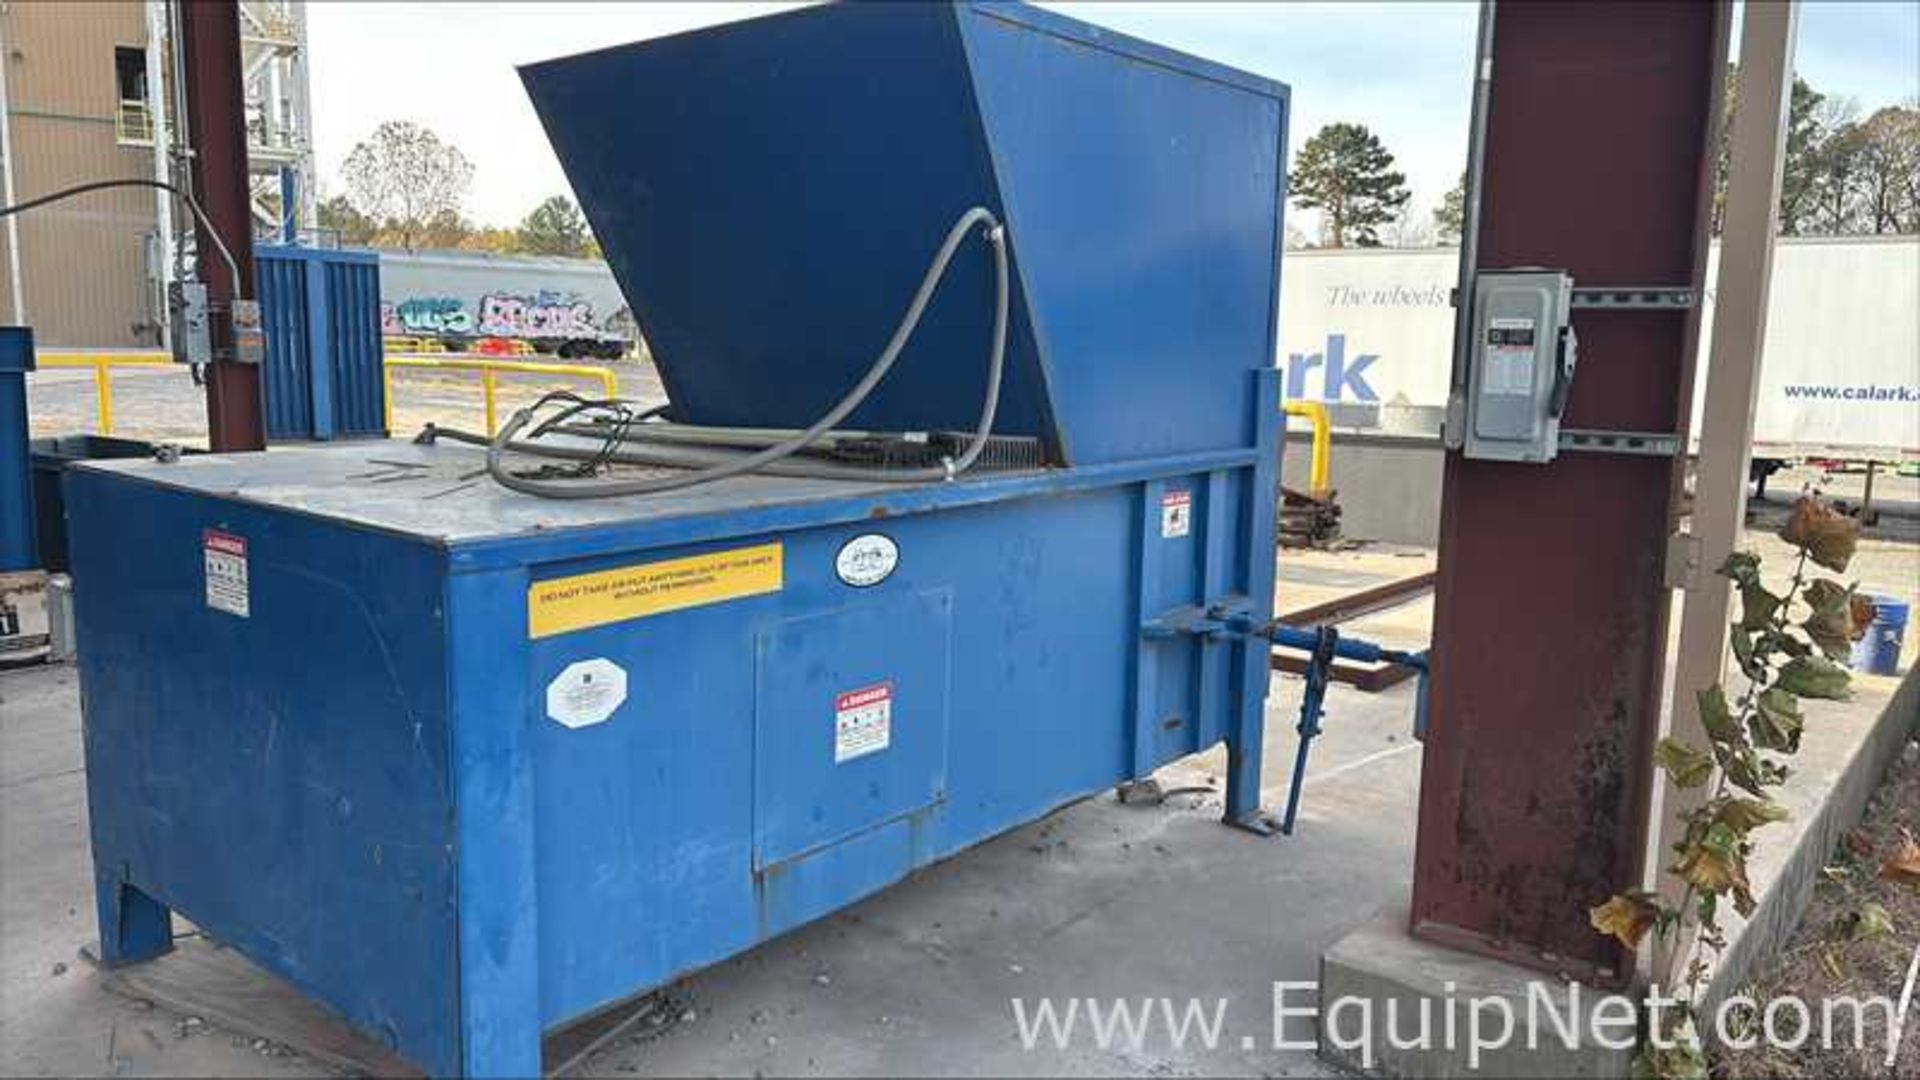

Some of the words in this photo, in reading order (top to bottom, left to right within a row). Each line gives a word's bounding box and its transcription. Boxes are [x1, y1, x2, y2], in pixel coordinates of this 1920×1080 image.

[1326, 286, 1367, 306] The
[1372, 284, 1446, 307] wheels
[1286, 334, 1382, 401] rk
[1784, 385, 1920, 401] www.calark.
[539, 591, 557, 604] DO
[557, 587, 580, 601] NOT
